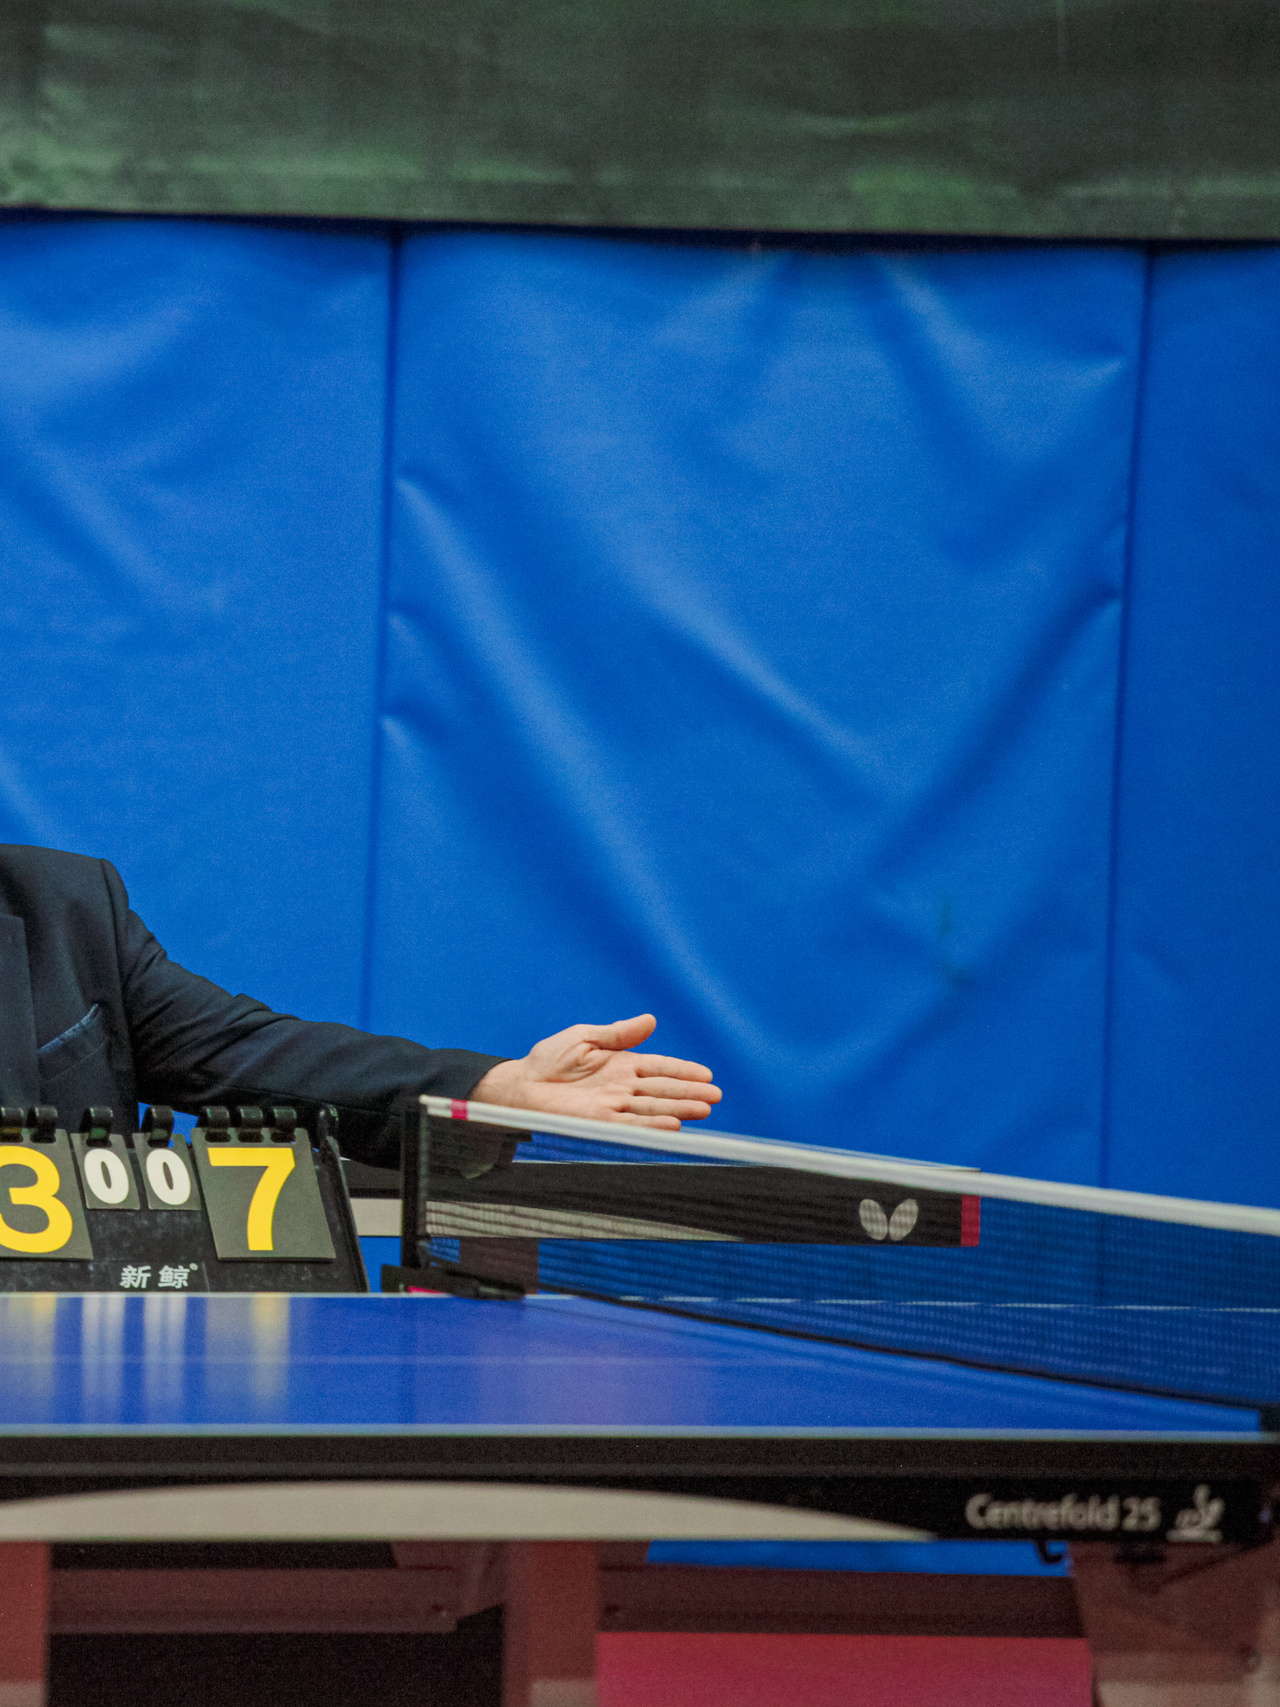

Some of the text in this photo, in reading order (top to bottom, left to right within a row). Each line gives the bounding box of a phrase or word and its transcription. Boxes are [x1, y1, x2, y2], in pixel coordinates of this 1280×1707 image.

[207, 1147, 296, 1251] 7
[965, 1493, 1119, 1530] Centrefold
[1122, 1497, 1161, 1531] 25
